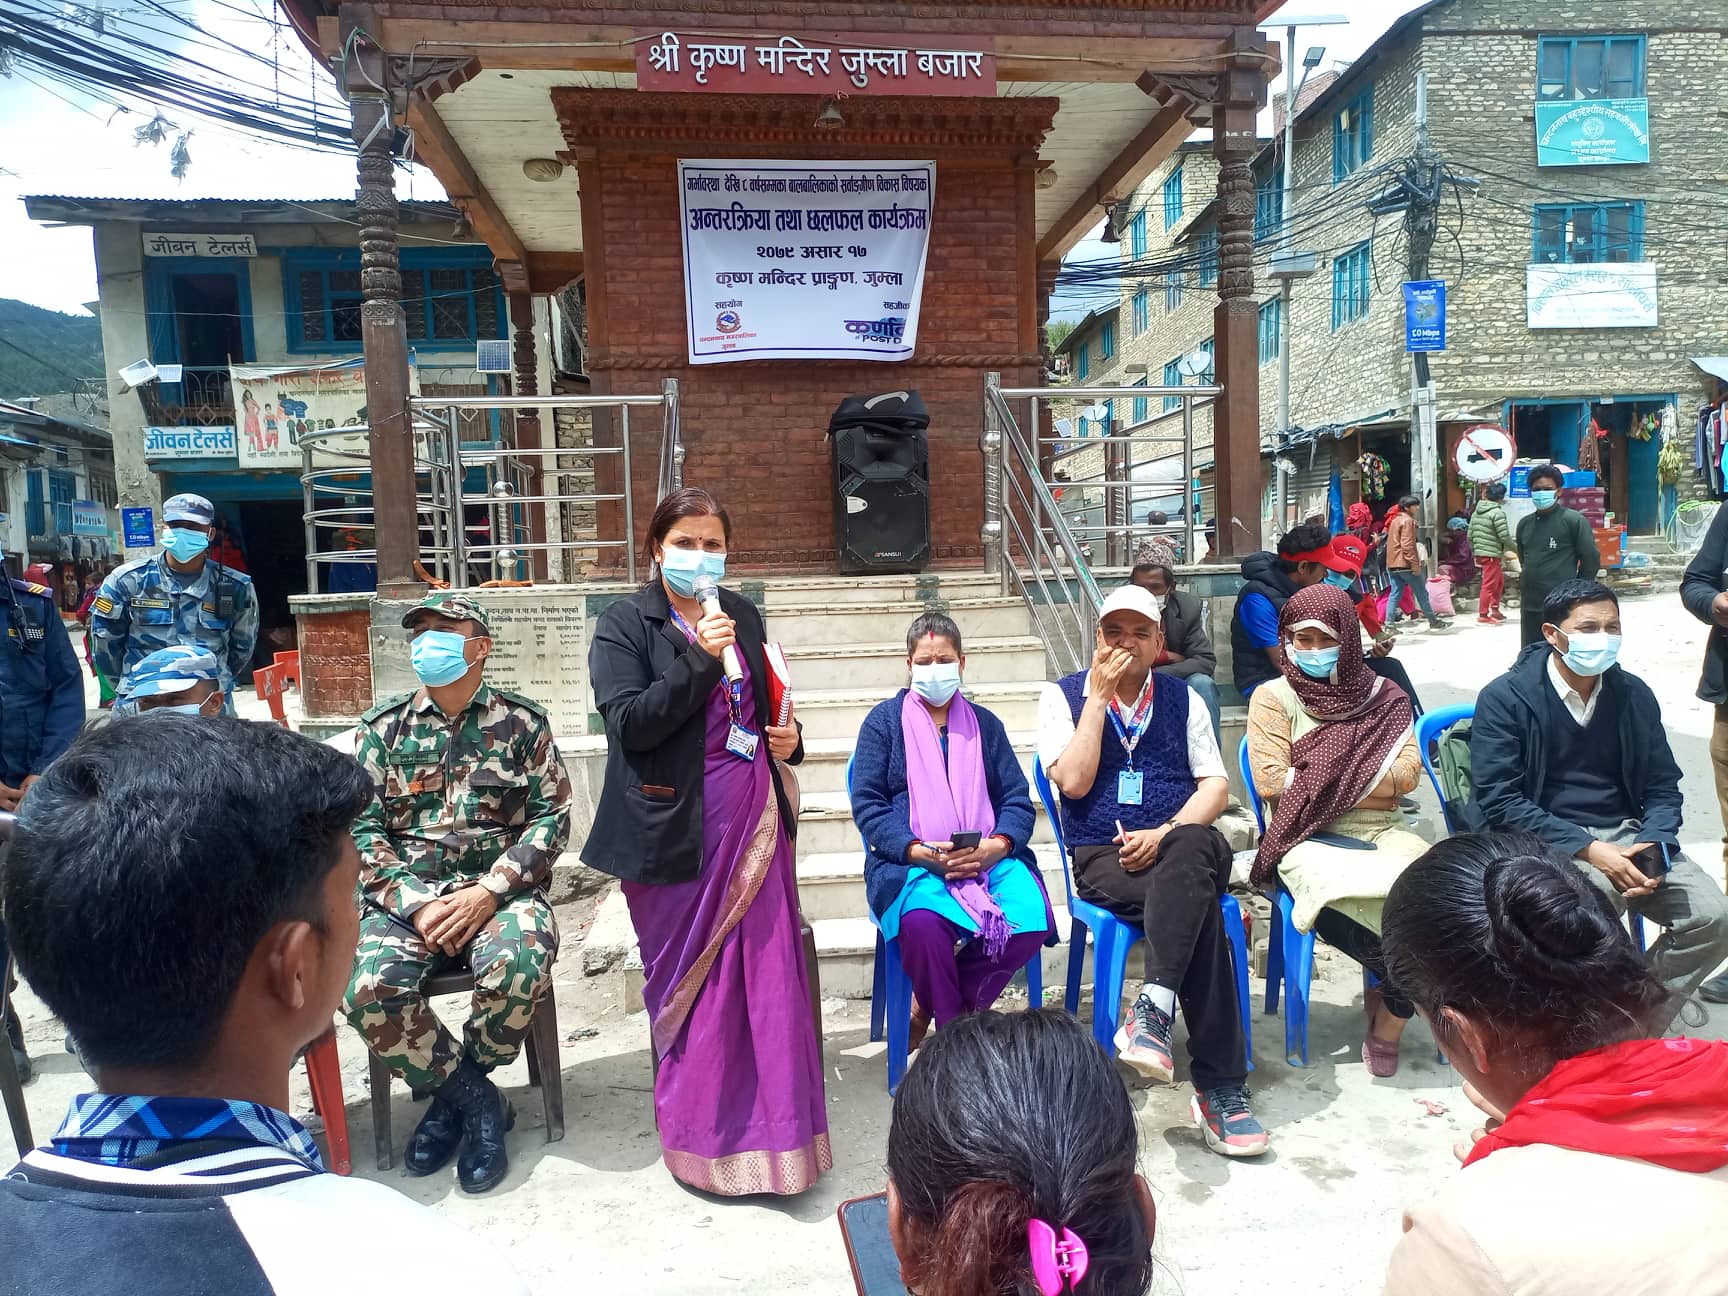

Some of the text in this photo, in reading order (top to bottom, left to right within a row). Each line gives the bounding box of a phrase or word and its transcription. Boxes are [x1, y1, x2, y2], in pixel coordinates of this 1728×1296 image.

[648, 31, 984, 88] श्री कृष्ण मन्दिर जुम्ला बजार
[687, 174, 720, 192] गर्भावस्था
[724, 173, 740, 192] देखि
[742, 178, 748, 192] ८
[749, 175, 786, 193] वर्षसम्मका
[788, 174, 839, 193] बालबालिकाको
[876, 174, 900, 192] विकास
[901, 174, 927, 192] विषयक
[689, 201, 927, 232] अन्तरक्रिया तथा छलफल कार्यक्रम
[207, 236, 252, 255] टेलर्स
[757, 245, 867, 259] २०७९ असार १७
[715, 271, 753, 288] कृष्ण
[758, 268, 807, 286] मन्दिर
[862, 271, 903, 288] जुम्ला
[715, 299, 744, 310] सहयोग
[862, 335, 890, 344] POST
[145, 427, 233, 449] जीवन टेलर्स
